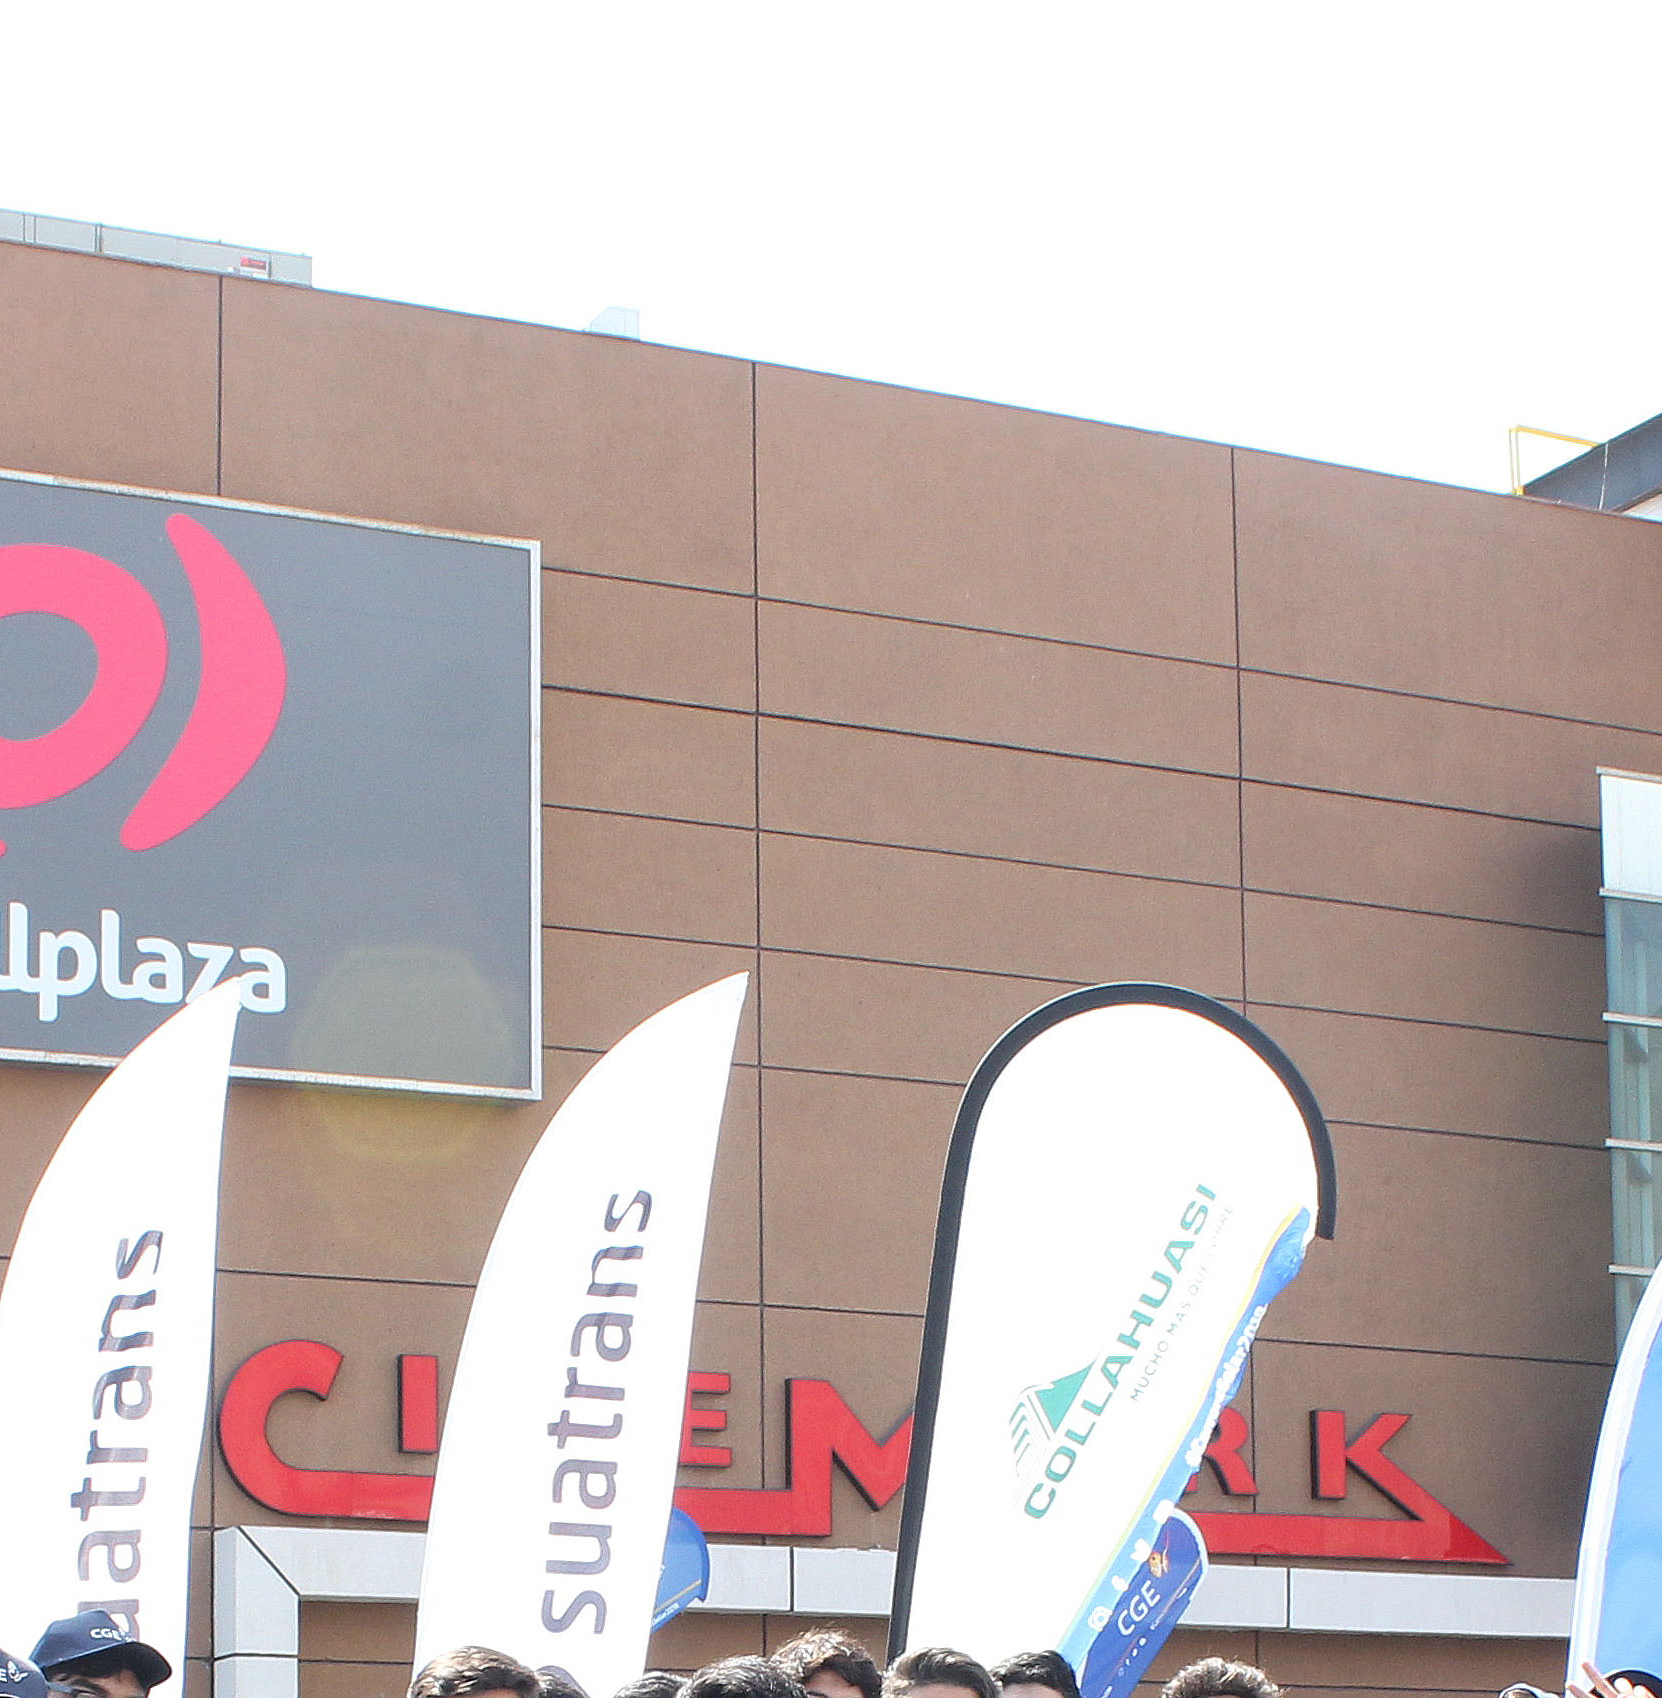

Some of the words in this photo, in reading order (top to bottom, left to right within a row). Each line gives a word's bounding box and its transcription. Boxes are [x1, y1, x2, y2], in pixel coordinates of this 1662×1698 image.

[541, 1189, 653, 1635] suatrans
[1023, 1183, 1216, 1519] COLLAHUASI
[1129, 1339, 1171, 1402] MUCHO
[1166, 1302, 1191, 1337] MAS
[1117, 1580, 1161, 1637] CGE
